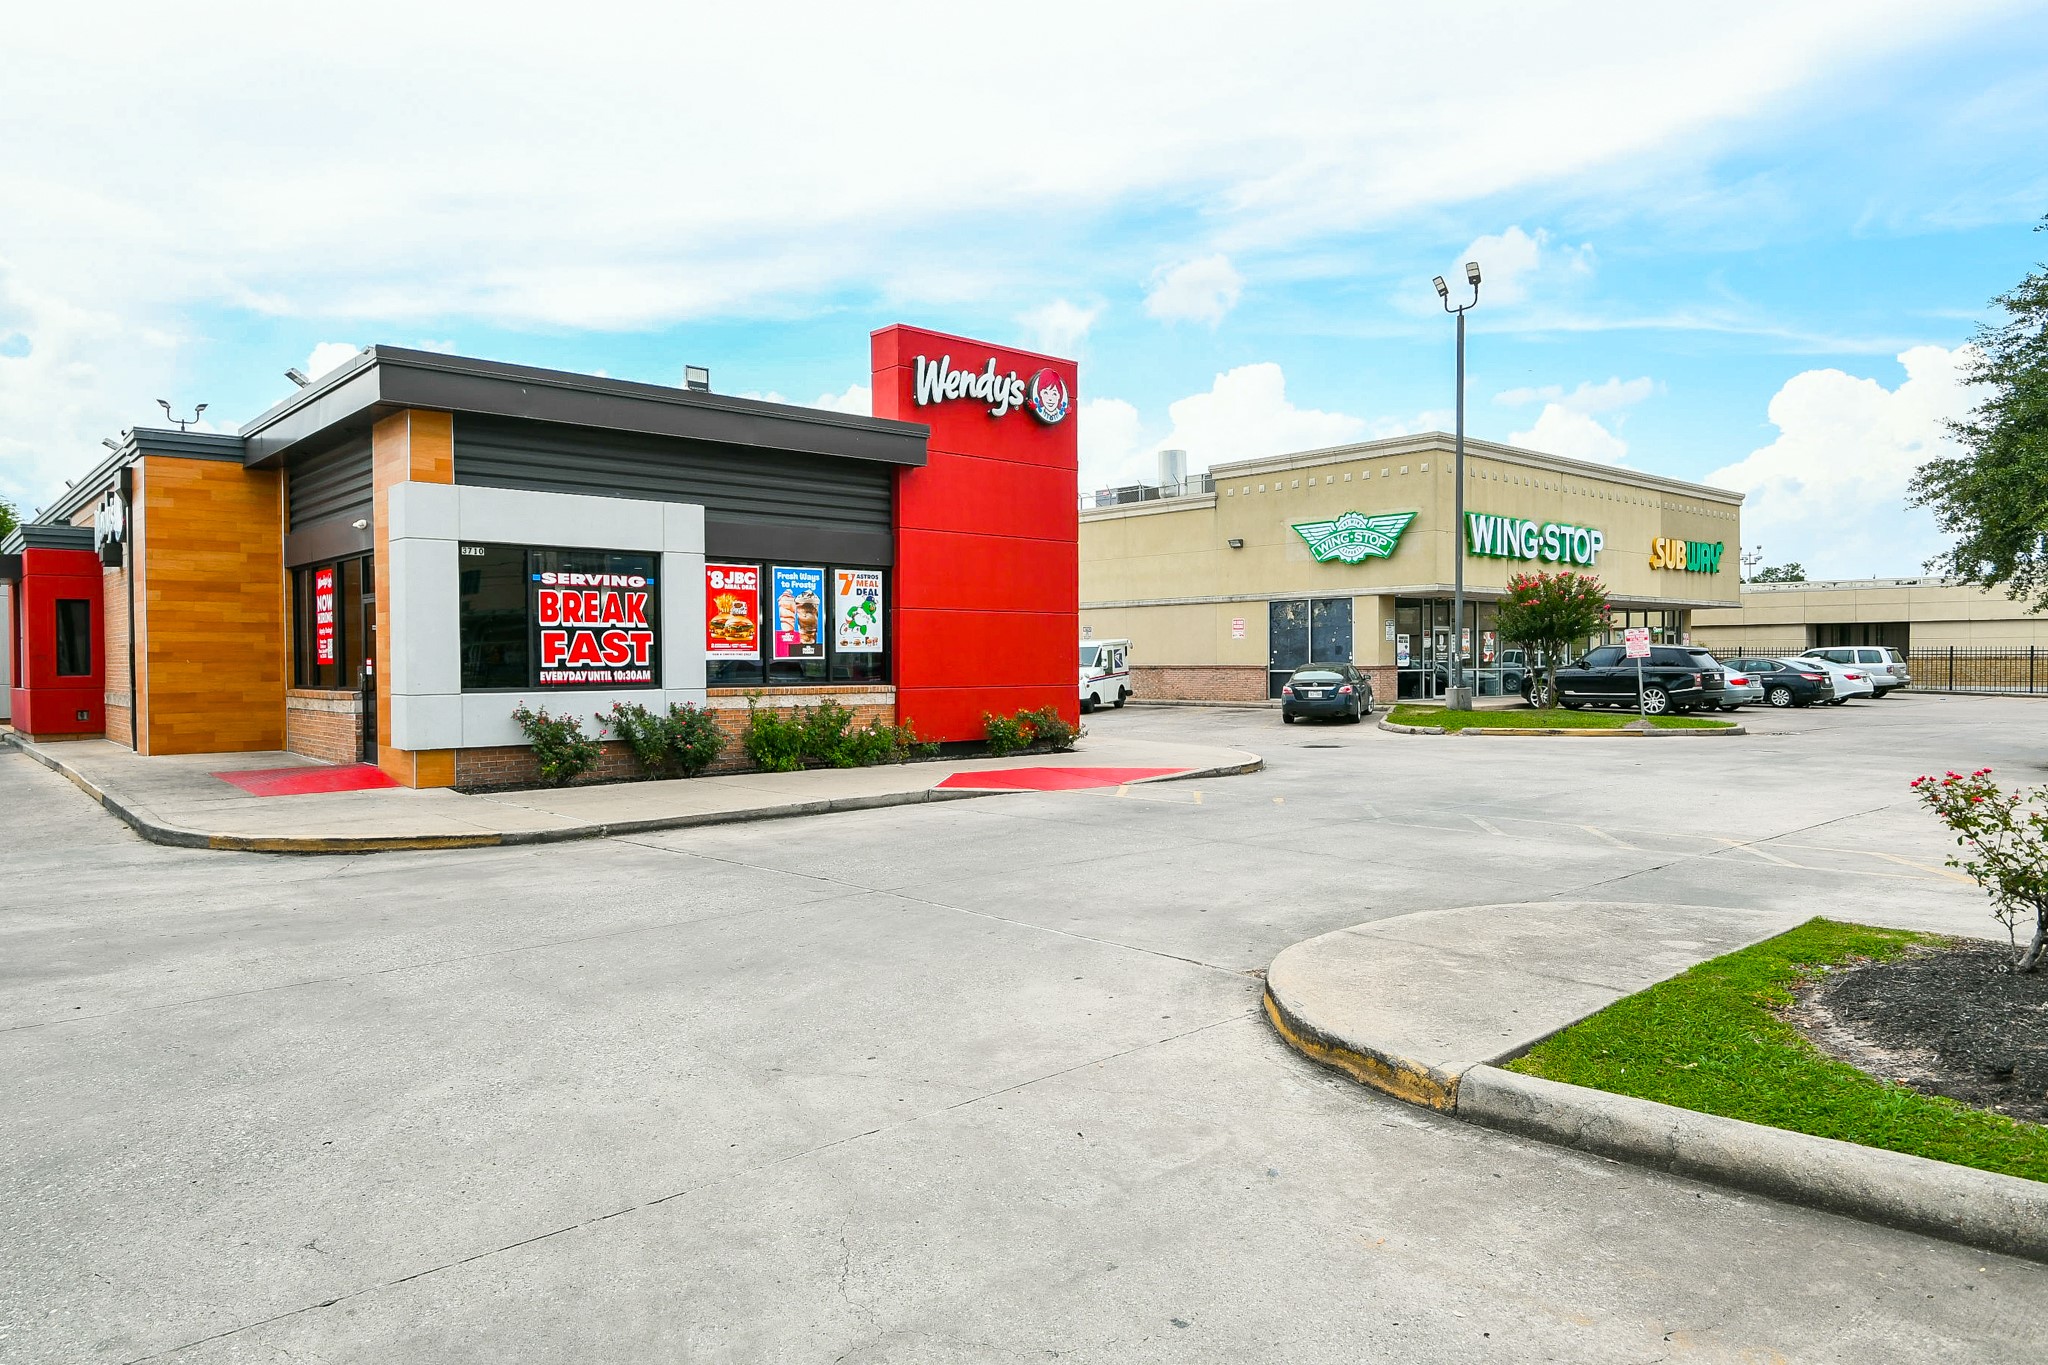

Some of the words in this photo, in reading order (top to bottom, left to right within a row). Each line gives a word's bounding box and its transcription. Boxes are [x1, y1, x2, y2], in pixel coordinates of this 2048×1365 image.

[915, 354, 1026, 417] Wendy's
[461, 547, 484, 555] 3710
[1650, 537, 1724, 573] SUBWAY
[541, 572, 647, 588] SERVING
[724, 571, 757, 584] JBC
[777, 571, 799, 580] Fresh
[799, 572, 820, 583] Ways
[856, 580, 879, 588] MEAL
[781, 580, 790, 588] to
[791, 581, 817, 591] Frosty
[856, 588, 879, 597] DEAL
[317, 594, 332, 611] NOW
[538, 589, 648, 627] BREAK
[541, 630, 653, 667] FAST
[540, 670, 588, 684] EVERYDAY
[587, 670, 613, 682] UNTIL
[613, 669, 651, 682] 10:30AM
